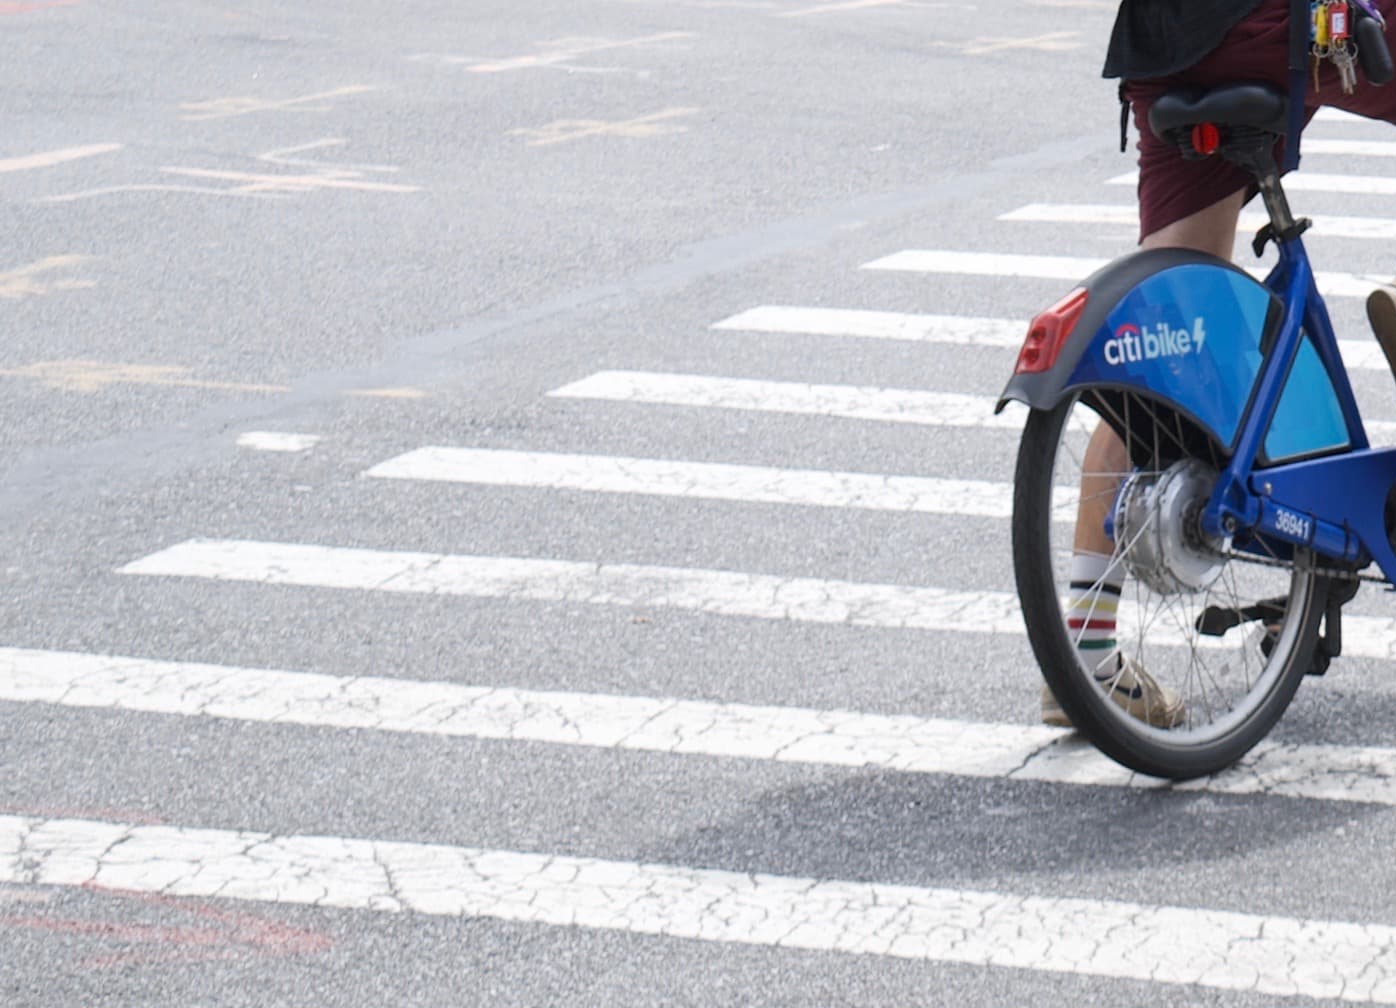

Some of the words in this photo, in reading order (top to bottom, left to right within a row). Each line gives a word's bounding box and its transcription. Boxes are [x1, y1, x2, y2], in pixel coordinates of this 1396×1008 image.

[1103, 328, 1143, 365] citi
[1141, 321, 1193, 360] bike
[1275, 509, 1310, 540] 36941
